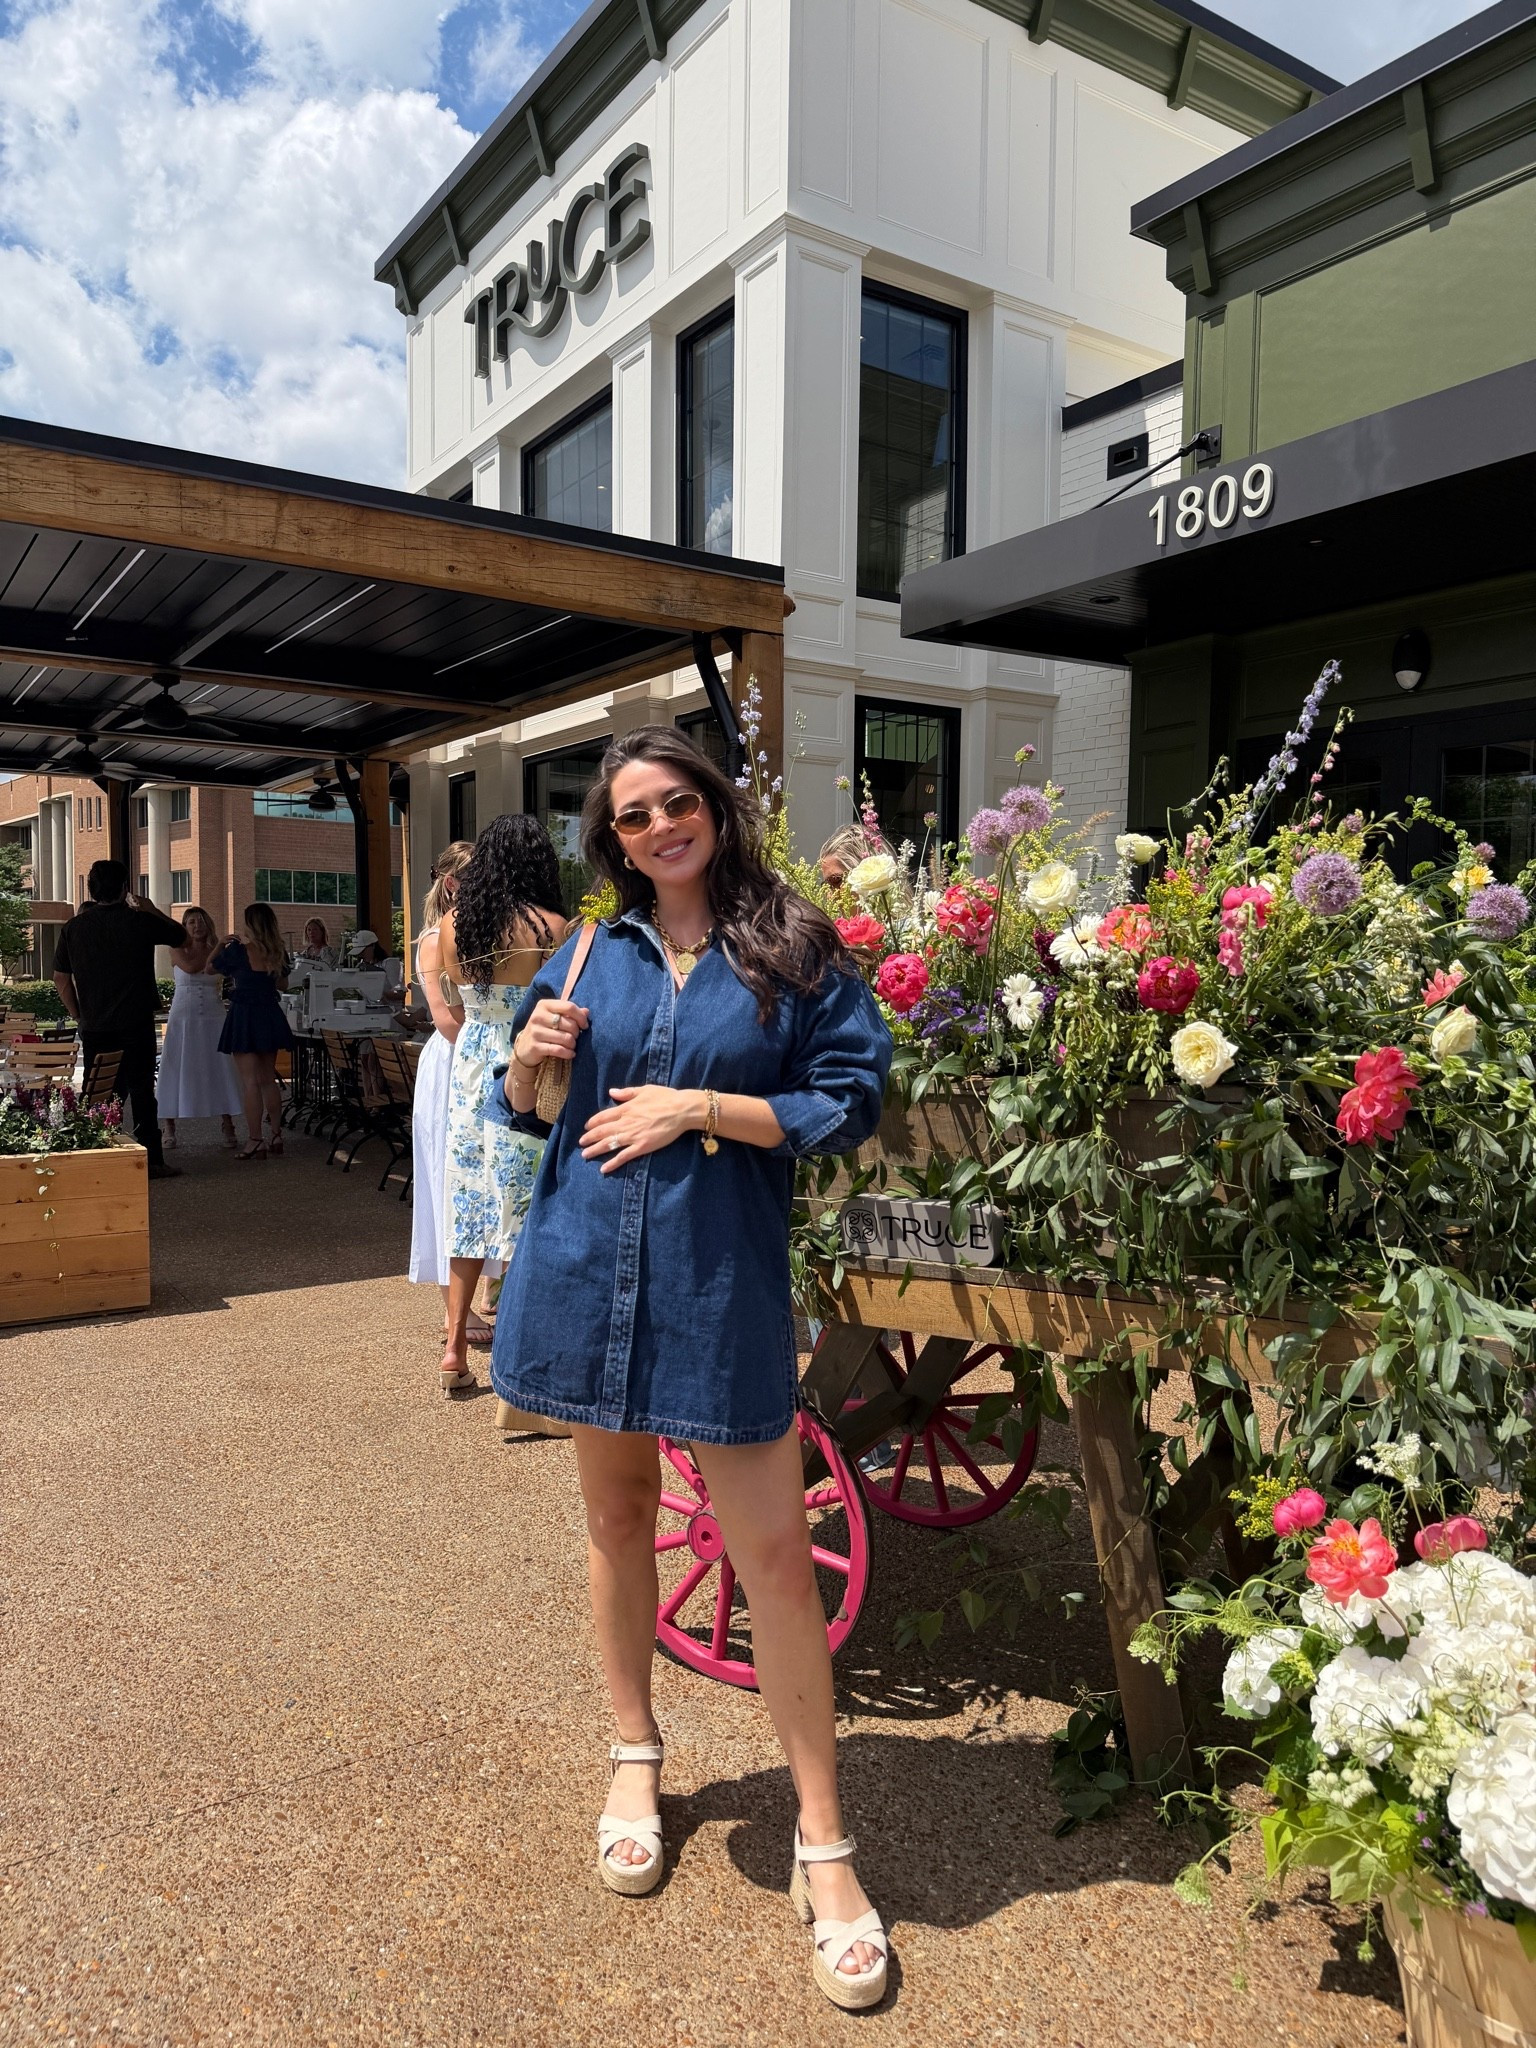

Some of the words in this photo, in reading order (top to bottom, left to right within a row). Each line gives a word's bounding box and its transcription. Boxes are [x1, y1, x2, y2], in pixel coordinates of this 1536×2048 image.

[464, 142, 651, 378] TRUCE
[1149, 463, 1273, 546] 1809
[881, 1216, 989, 1249] TRUCE
